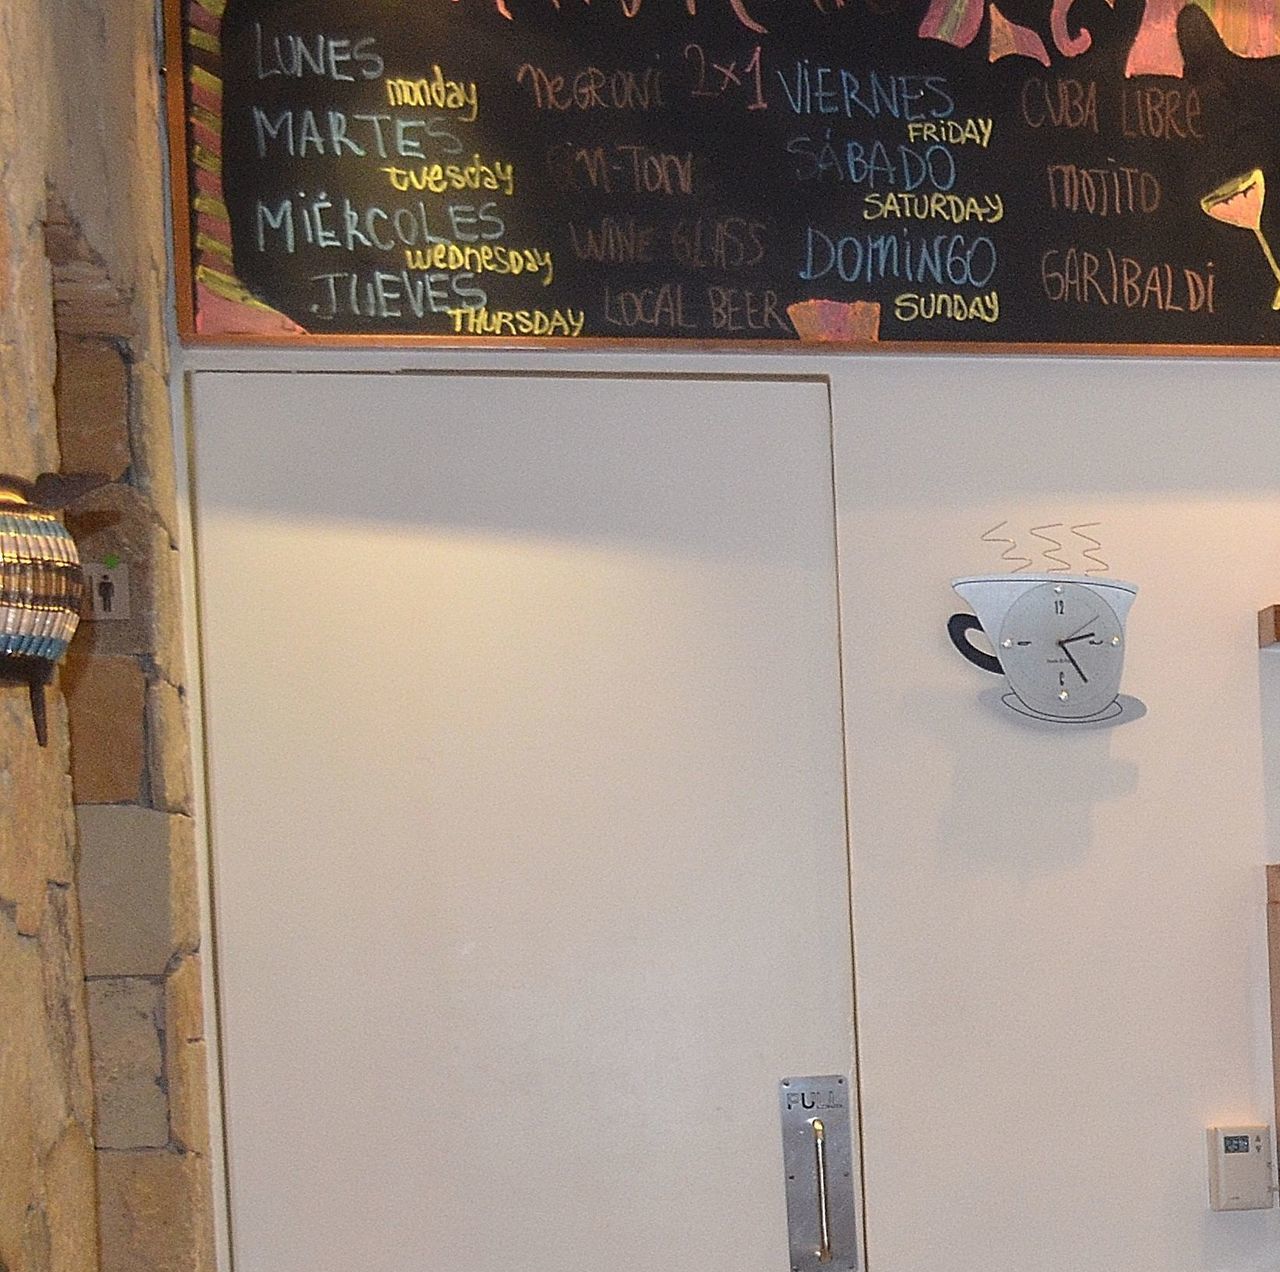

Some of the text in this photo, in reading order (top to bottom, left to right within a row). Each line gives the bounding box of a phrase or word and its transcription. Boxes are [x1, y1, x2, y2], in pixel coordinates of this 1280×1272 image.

[256, 23, 384, 82] LUNES
[386, 65, 479, 122] monday
[1021, 78, 1099, 133] CUBA
[253, 106, 463, 159] MARTES
[381, 154, 515, 196] tuesday
[863, 192, 1004, 223] SATURDAY
[309, 271, 488, 320] JUEVES
[605, 284, 792, 333] LOCAL BEER
[448, 306, 585, 337] THURSDAY
